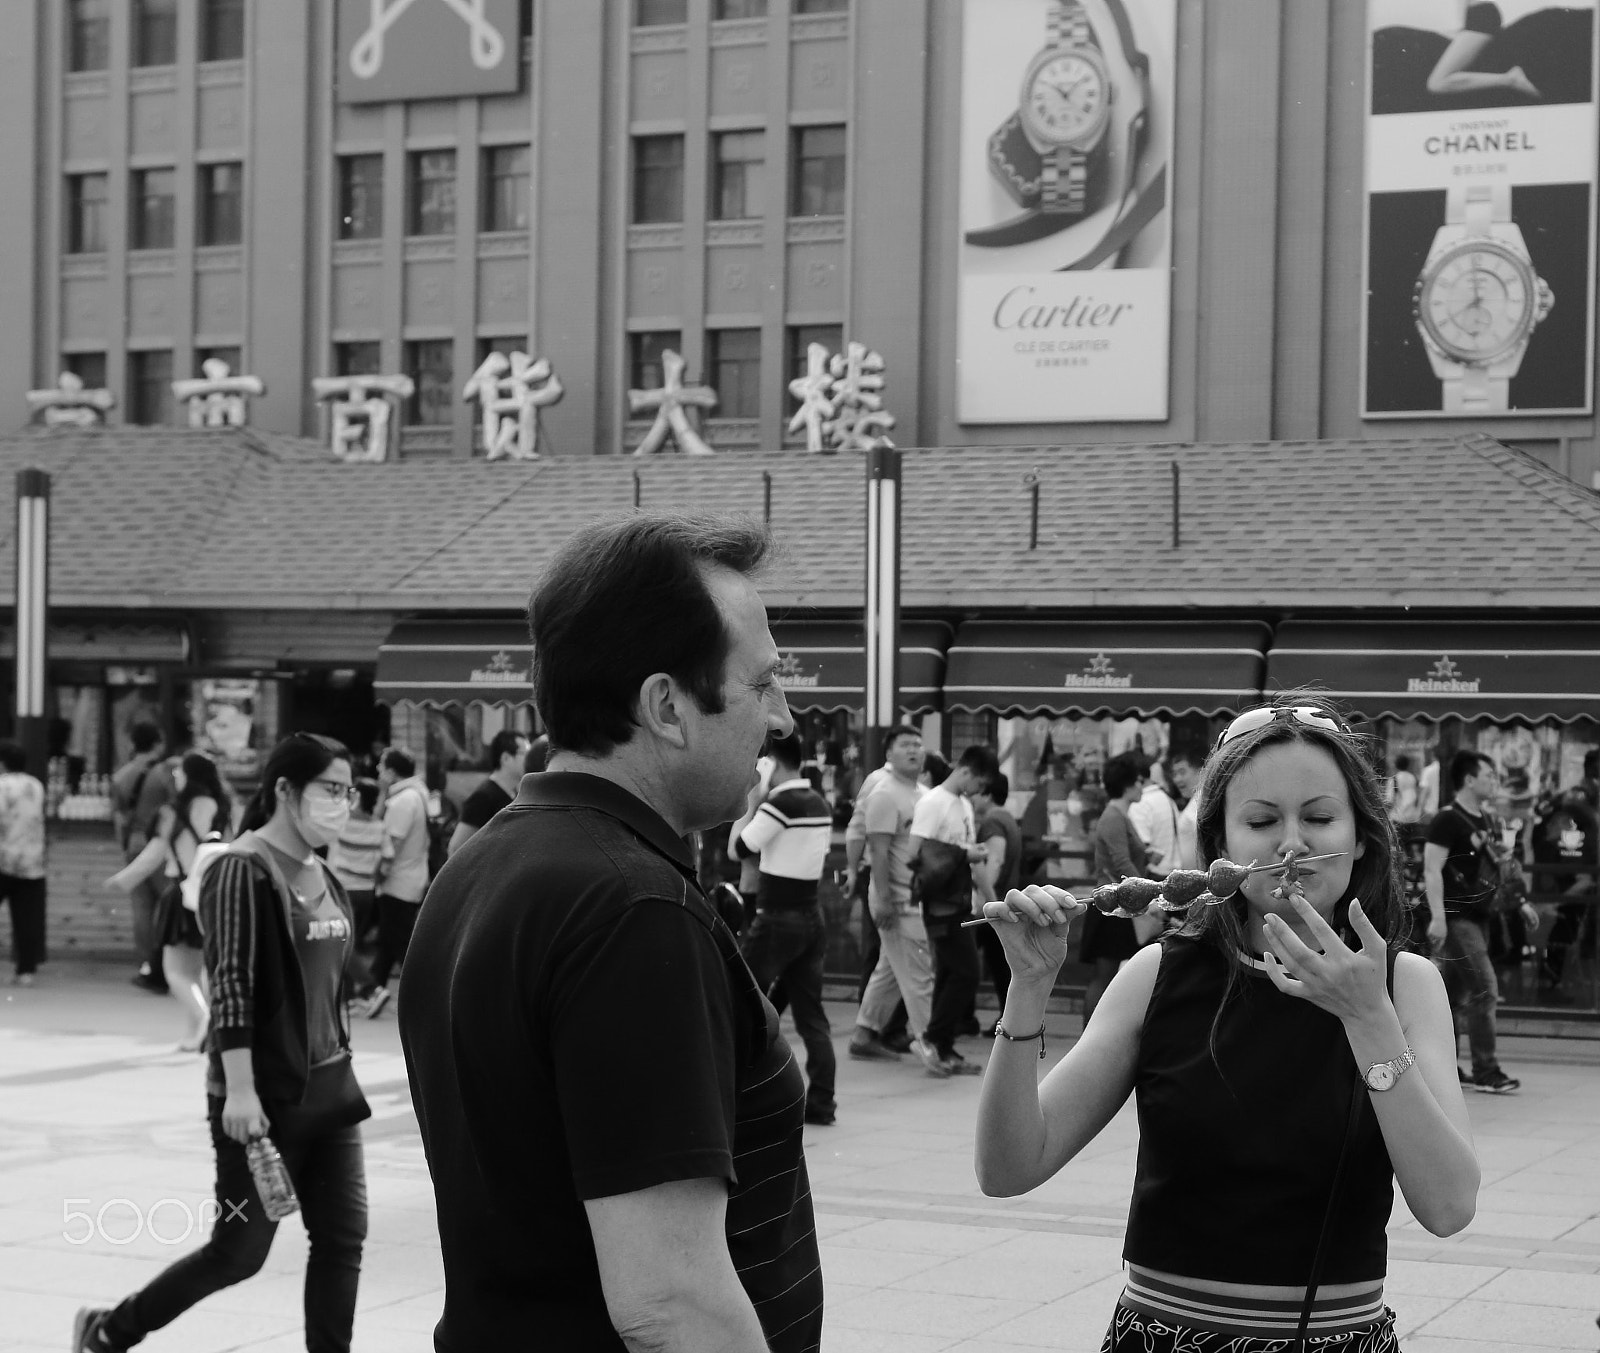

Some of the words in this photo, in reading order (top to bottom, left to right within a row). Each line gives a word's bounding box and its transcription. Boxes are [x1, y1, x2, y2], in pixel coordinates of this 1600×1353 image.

[1424, 131, 1536, 155] CHANEL
[993, 285, 1134, 330] Cartier
[470, 669, 529, 682] Heineken
[1065, 673, 1133, 687] Heineken
[1407, 678, 1480, 692] Heineken
